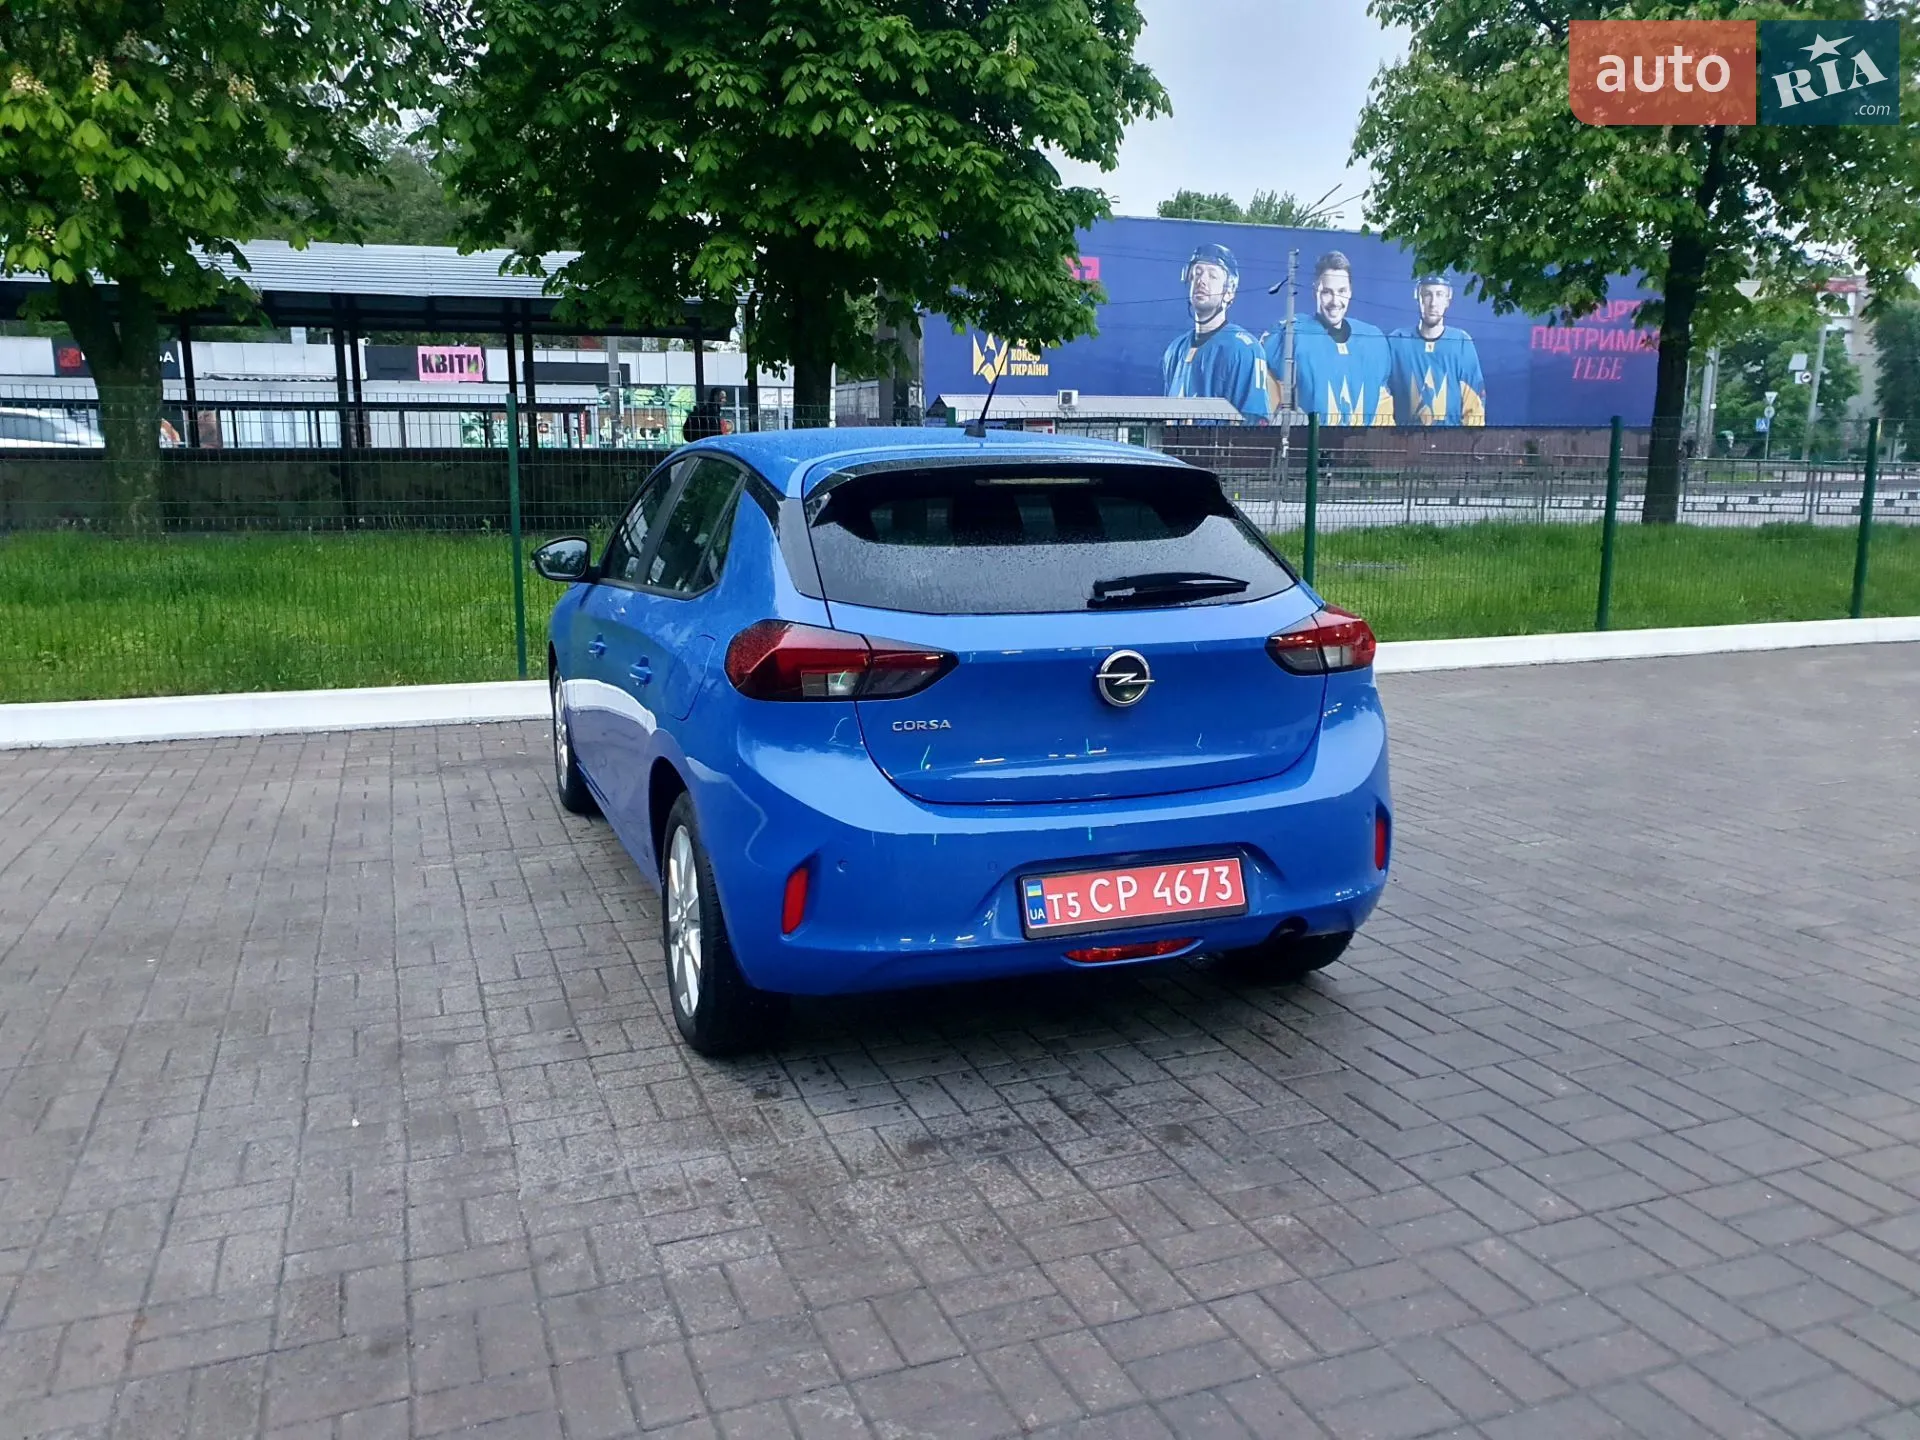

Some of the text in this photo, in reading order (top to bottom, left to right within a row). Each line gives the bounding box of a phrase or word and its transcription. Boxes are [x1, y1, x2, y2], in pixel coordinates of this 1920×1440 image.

[421, 353, 480, 374] КВІТИ
[1010, 361, 1049, 376] УКРАЇНИ
[1572, 355, 1625, 381] ТЕБЕ
[892, 719, 952, 732] CORSA
[1089, 875, 1139, 914] CP
[1152, 865, 1233, 907] 4673
[1029, 908, 1046, 921] UA
